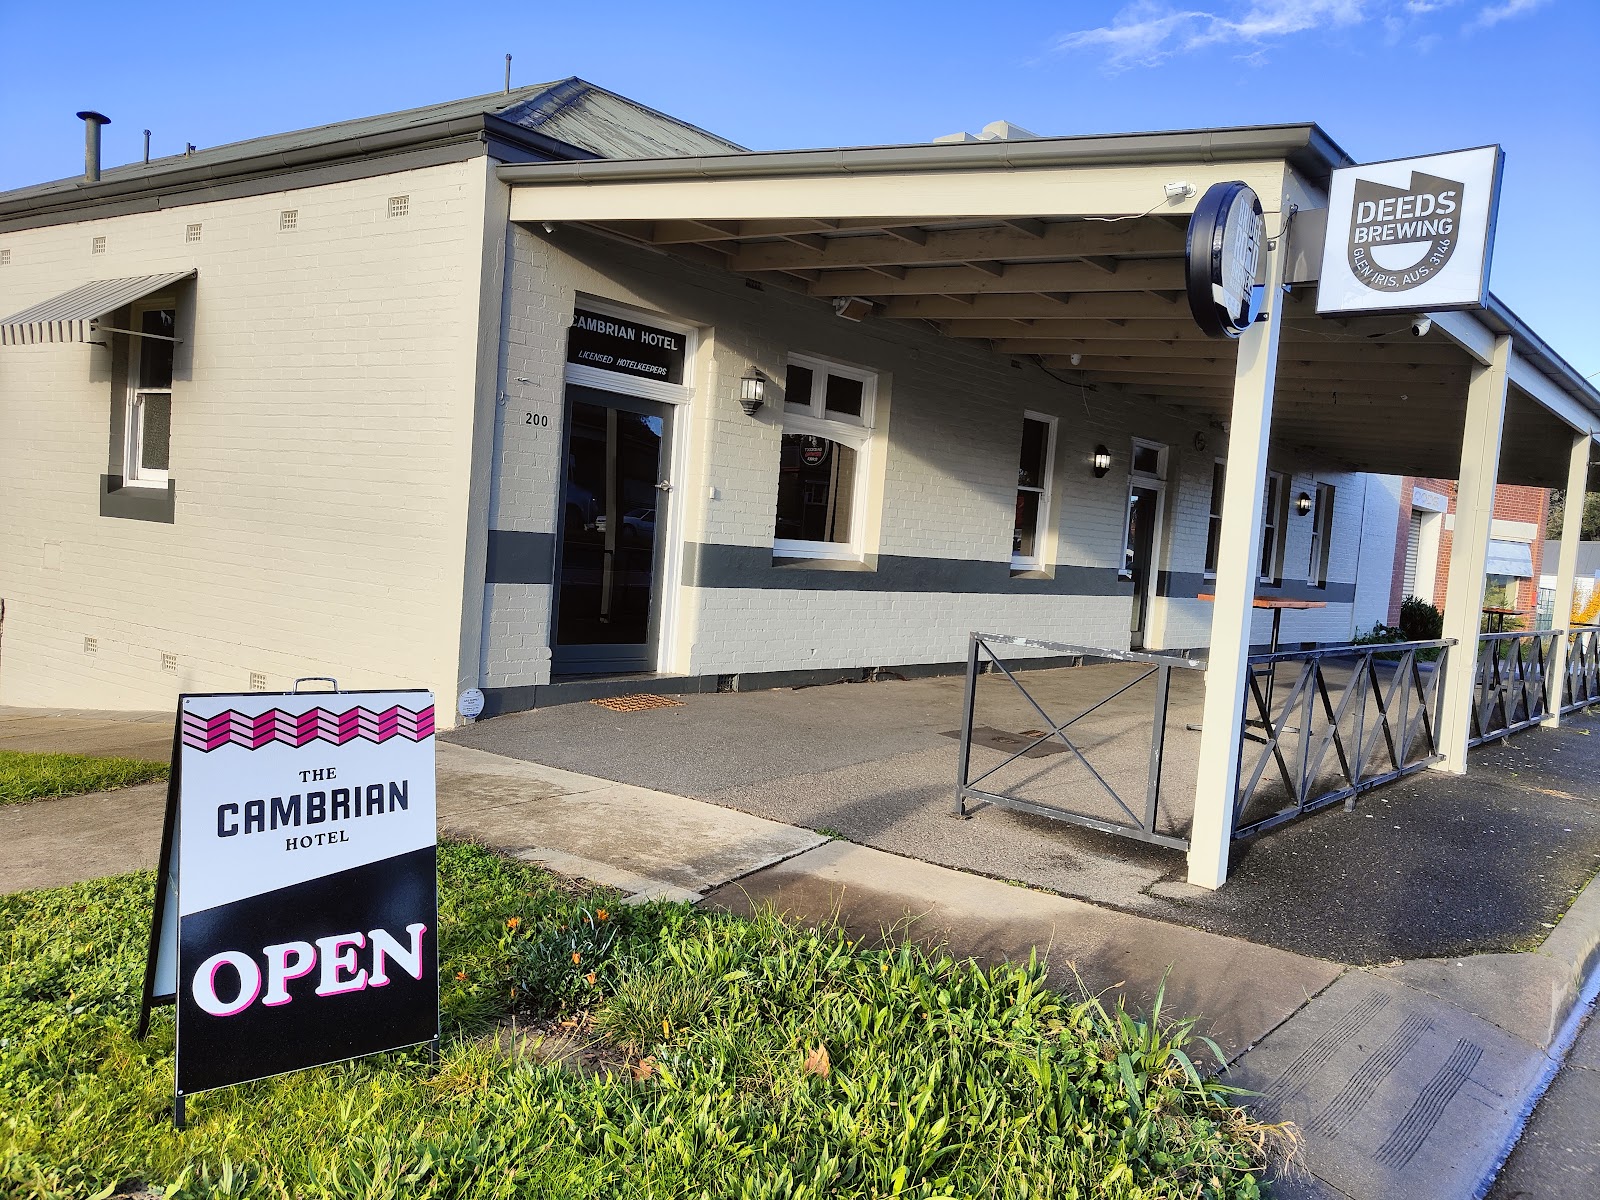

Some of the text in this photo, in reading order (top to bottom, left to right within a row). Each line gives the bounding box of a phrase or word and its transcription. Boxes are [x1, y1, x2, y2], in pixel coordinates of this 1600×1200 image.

[1356, 191, 1456, 224] DEEDS
[1354, 218, 1453, 244] BREWING
[1353, 247, 1374, 277] GLEN
[1371, 272, 1400, 288] IRIS,
[1429, 239, 1451, 266] 3146
[572, 314, 678, 351] CAMBRIAN HOTEL
[578, 349, 668, 376] LICENSED HOTELKEEPERS
[525, 412, 548, 427] 200
[298, 767, 337, 783] THE
[217, 780, 409, 838] CAMBRIAN
[285, 830, 350, 851] HOTEL
[192, 922, 427, 1017] OPEN
